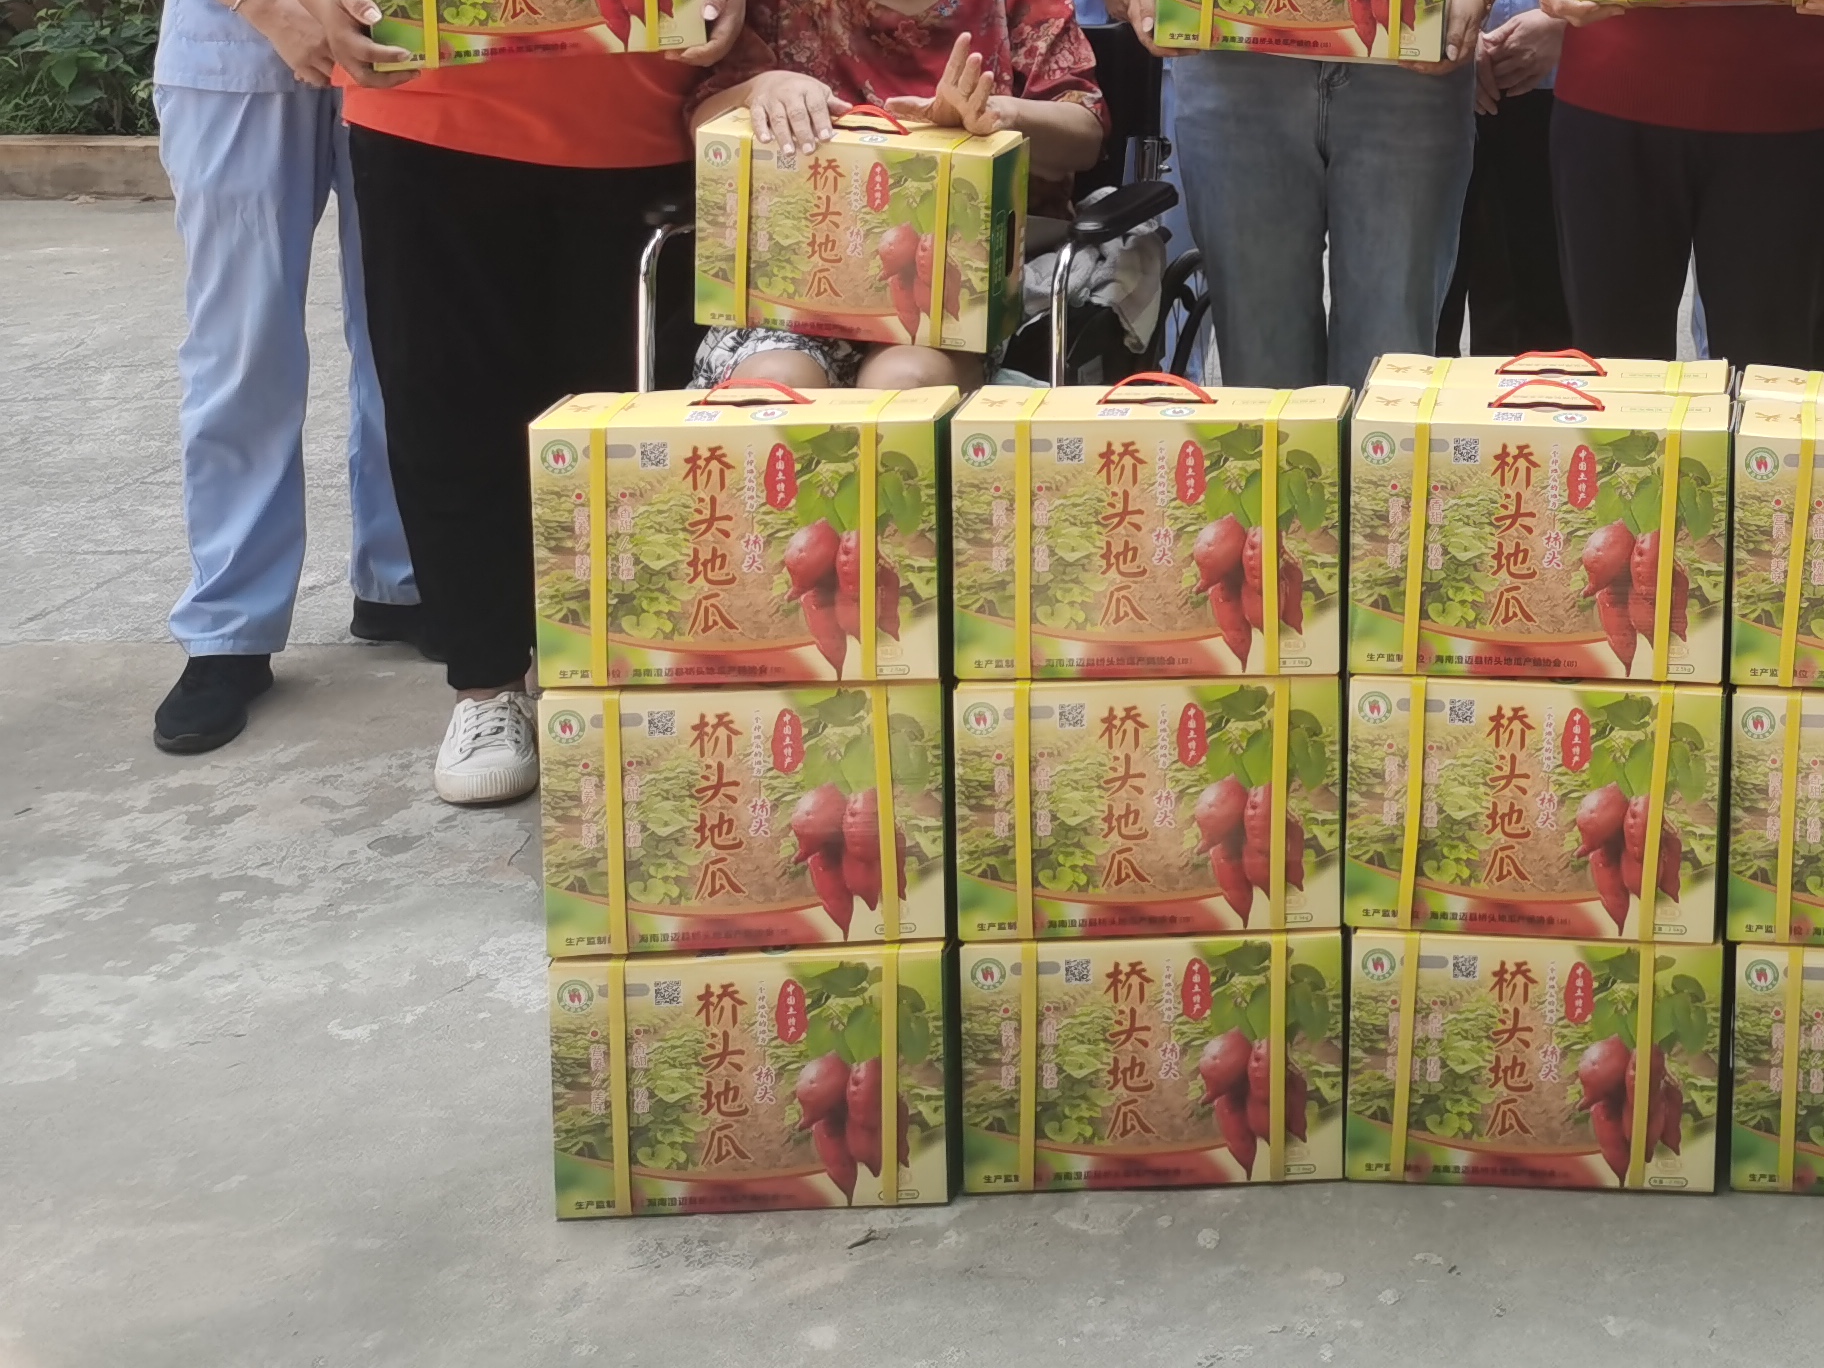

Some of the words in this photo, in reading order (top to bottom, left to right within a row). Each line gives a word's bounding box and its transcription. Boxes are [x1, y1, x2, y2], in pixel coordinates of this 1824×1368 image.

[805, 156, 846, 301] 桥头地瓜
[775, 447, 786, 504] 中国土特产
[1185, 444, 1195, 499] 中国土特产
[1577, 449, 1587, 504] 中国土特产
[681, 444, 739, 635] 桥头地瓜
[742, 534, 762, 572] 桥头
[1096, 441, 1149, 626] 桥头地瓜
[1153, 528, 1172, 565] 桥头
[1489, 443, 1541, 626] 桥头地瓜
[1544, 532, 1562, 568] 桥头
[688, 711, 746, 900] 桥头地瓜
[749, 799, 769, 836] 桥头
[1098, 704, 1150, 888] 桥头地瓜
[1155, 790, 1174, 827] 桥头
[1483, 705, 1536, 885] 桥头地瓜
[1538, 792, 1556, 828] 桥头
[694, 981, 752, 1165] 桥头地瓜
[1103, 960, 1155, 1140] 桥头地瓜
[1160, 1043, 1178, 1079] 桥头
[1485, 960, 1539, 1138] 桥头地瓜
[1540, 1046, 1559, 1081] 桥头
[754, 1067, 774, 1103] 桥头
